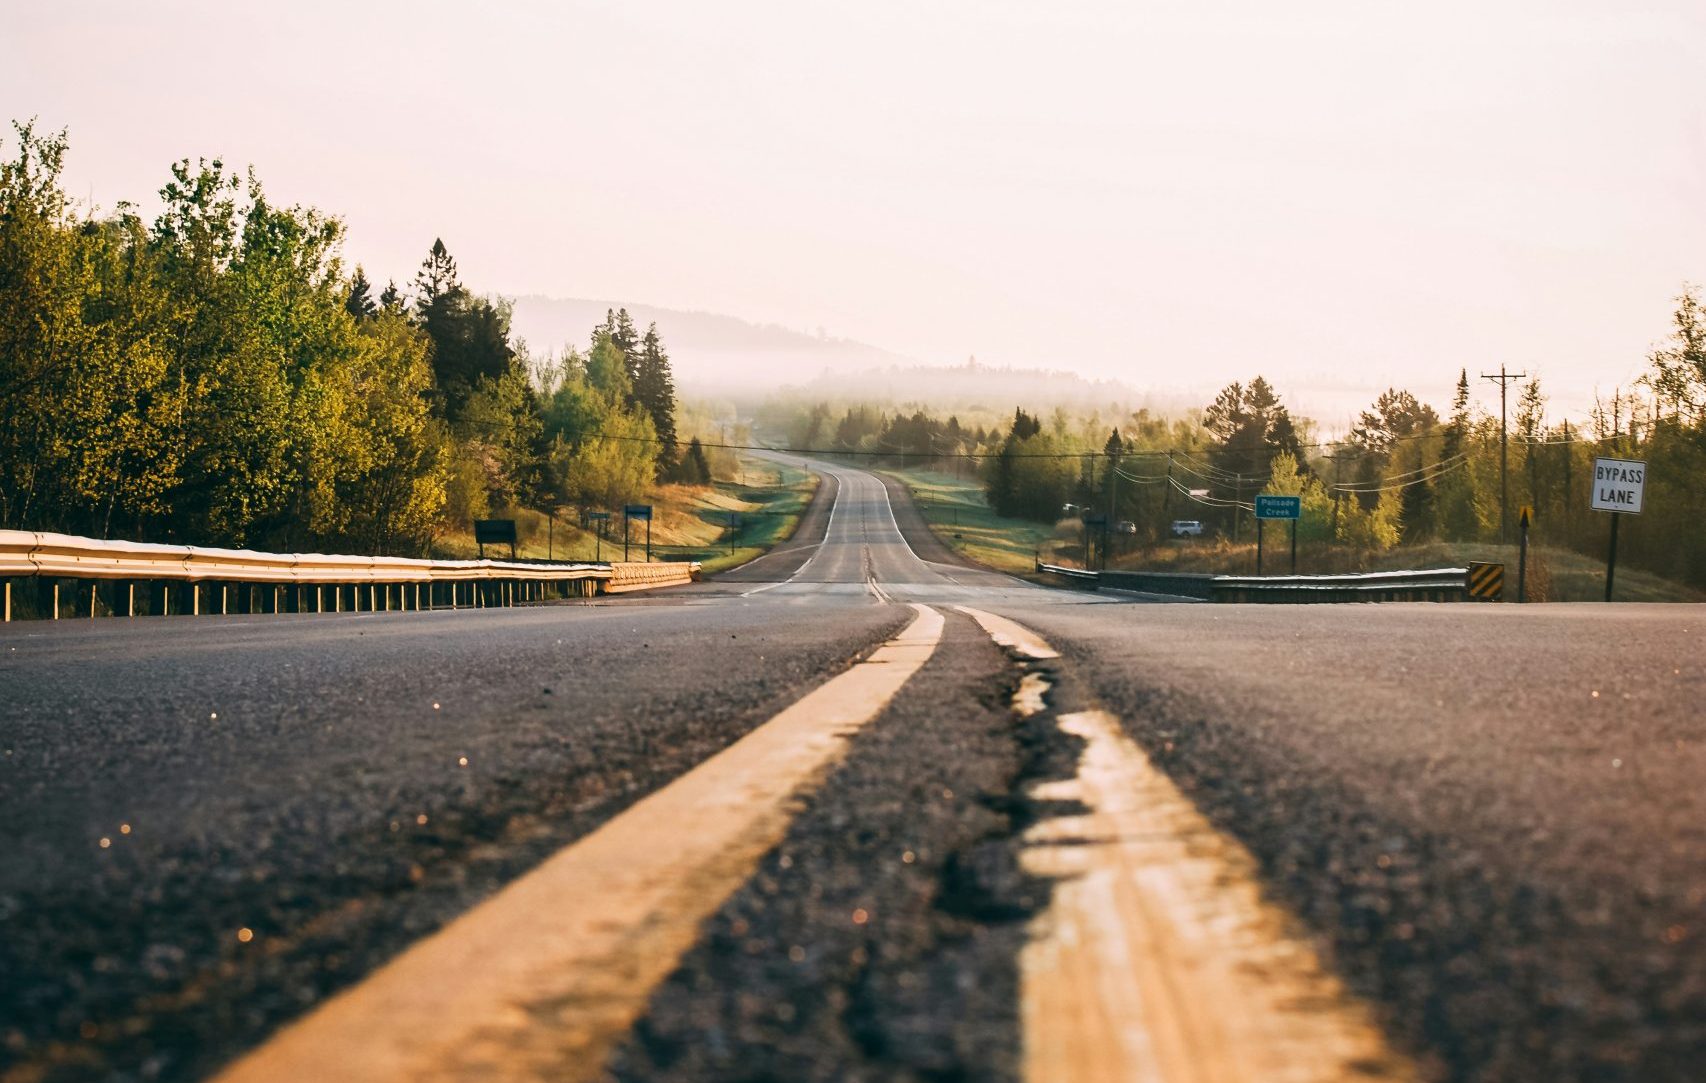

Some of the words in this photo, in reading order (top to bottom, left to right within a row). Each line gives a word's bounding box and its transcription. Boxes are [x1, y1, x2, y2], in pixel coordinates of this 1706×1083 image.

[1597, 467, 1642, 483] BYPASS
[1600, 488, 1635, 504] LANE
[1266, 508, 1290, 516] Creek
